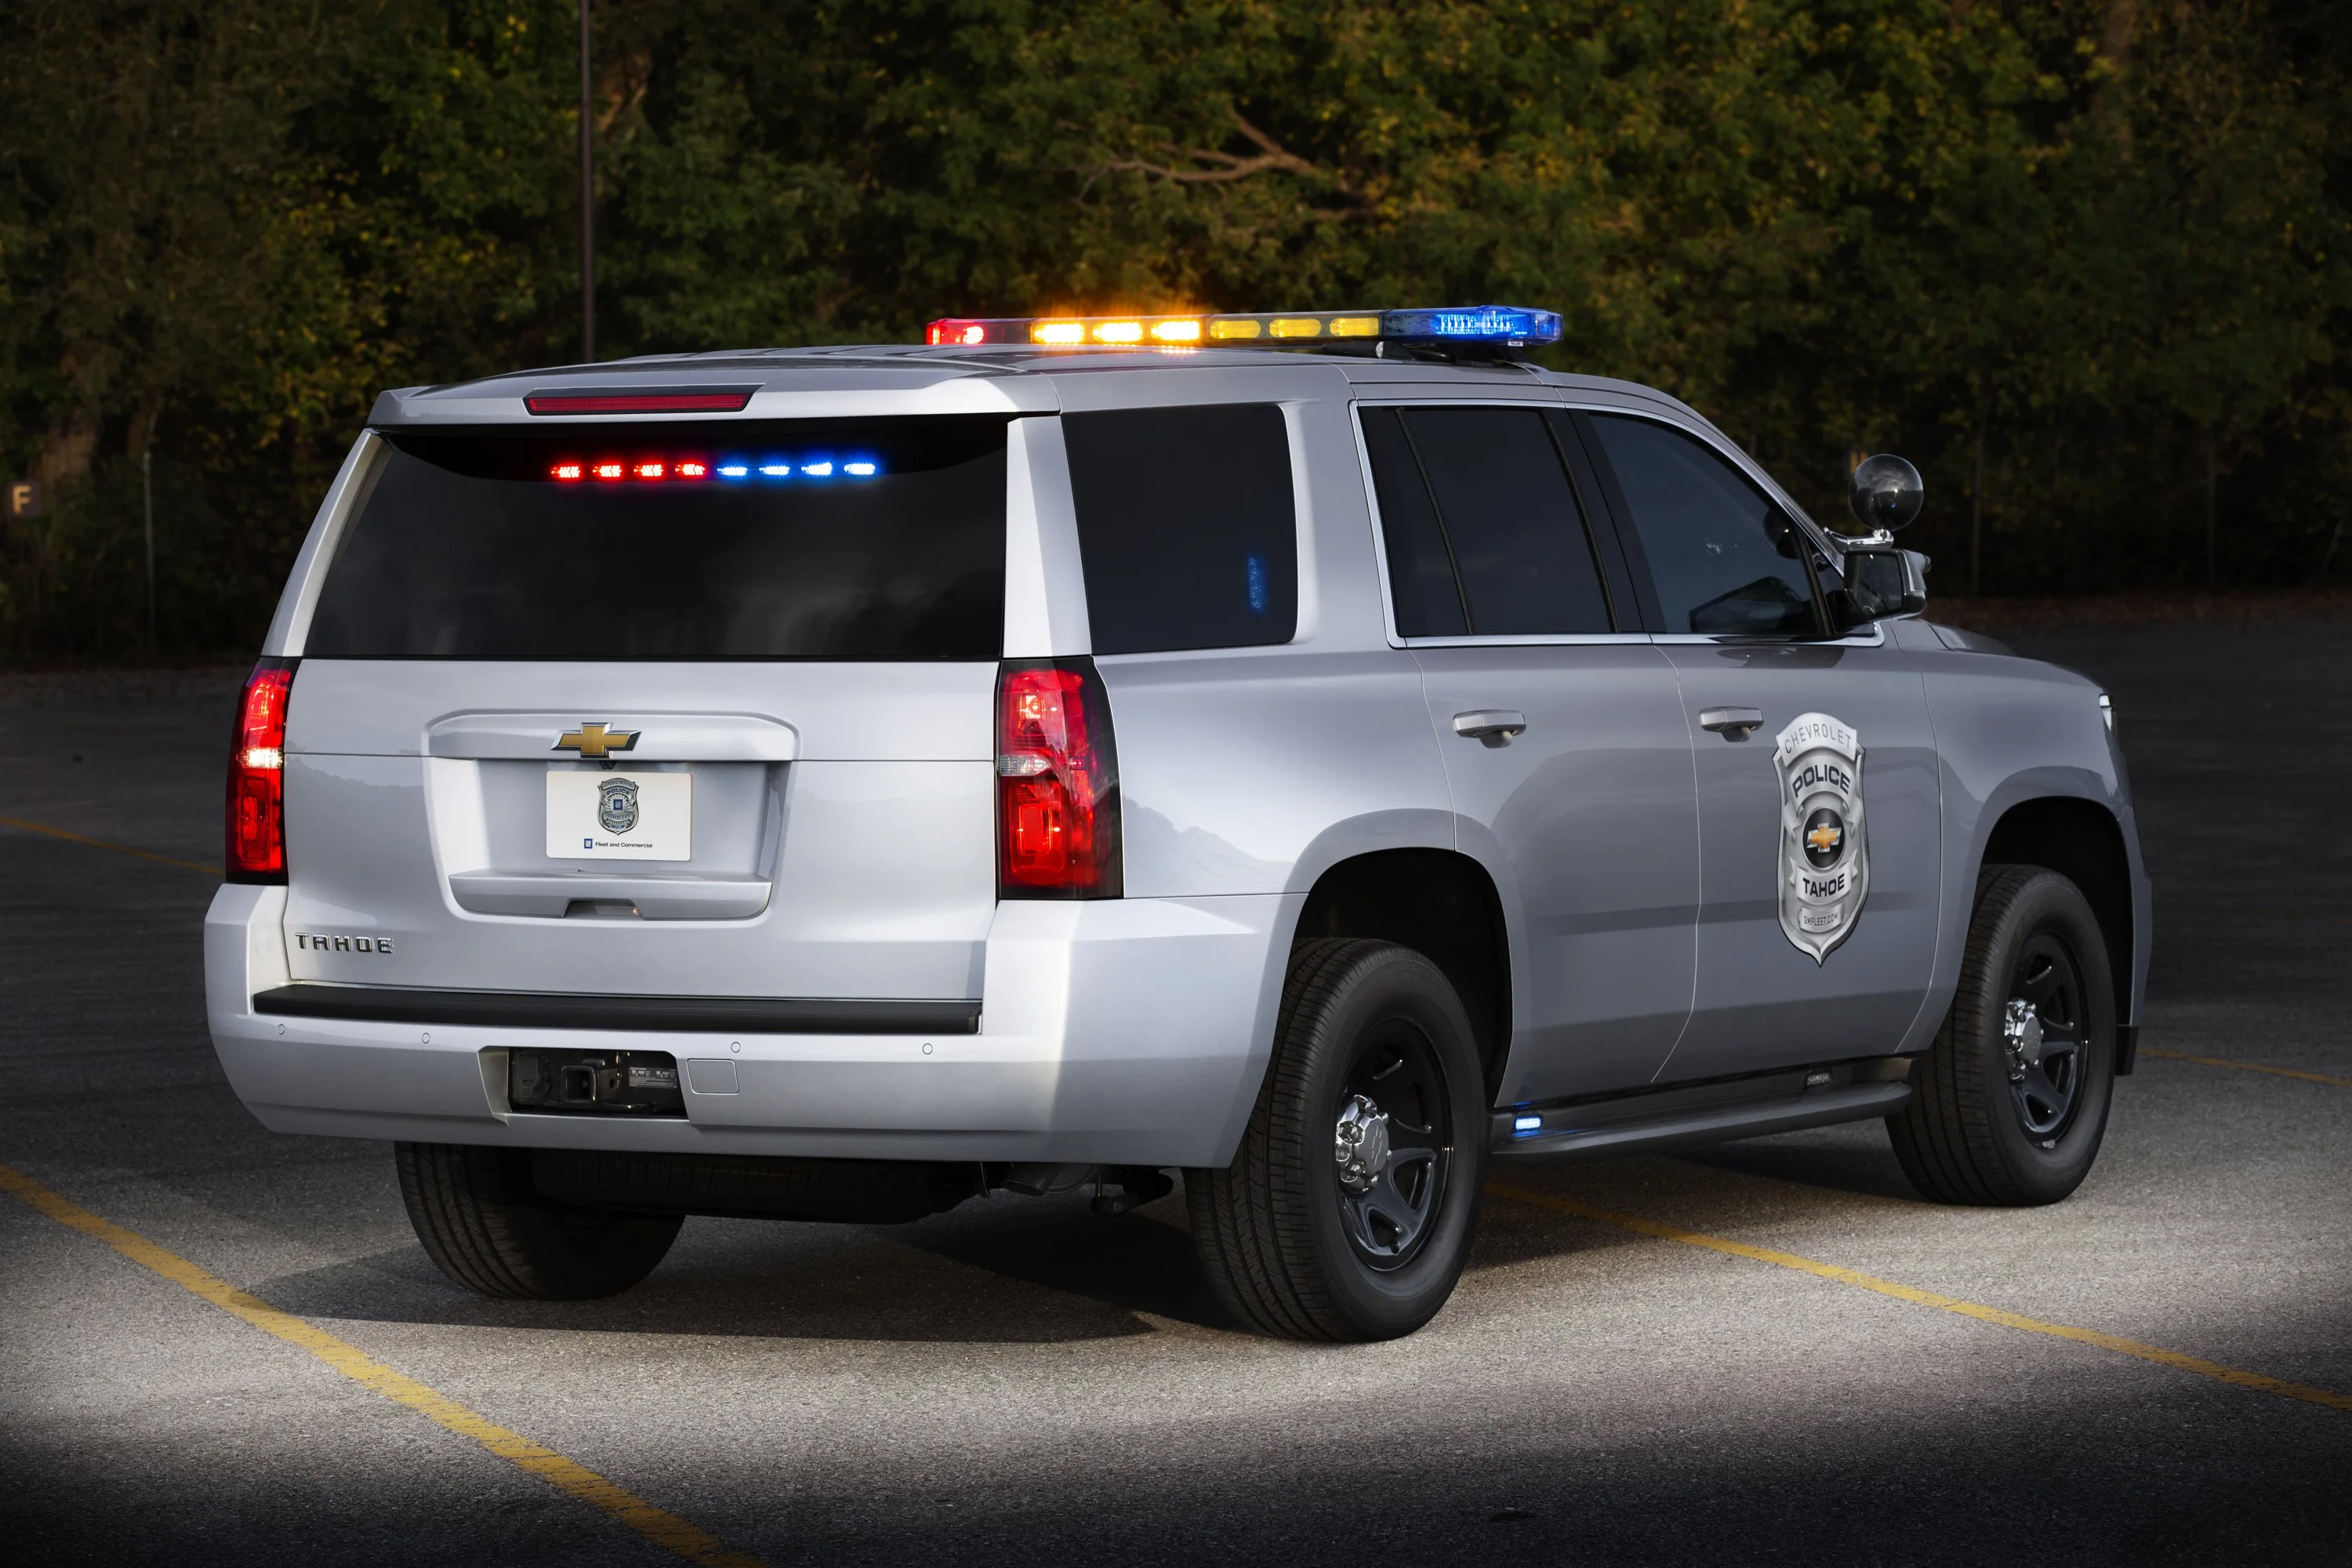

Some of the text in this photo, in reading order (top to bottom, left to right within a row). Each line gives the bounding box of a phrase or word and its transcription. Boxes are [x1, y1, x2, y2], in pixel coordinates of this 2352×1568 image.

[13, 485, 31, 514] F
[1784, 723, 1852, 754] CHEVROLET
[1792, 764, 1850, 798] POLICE
[1802, 873, 1845, 898] TAHOE
[295, 932, 395, 954] TAHOE
